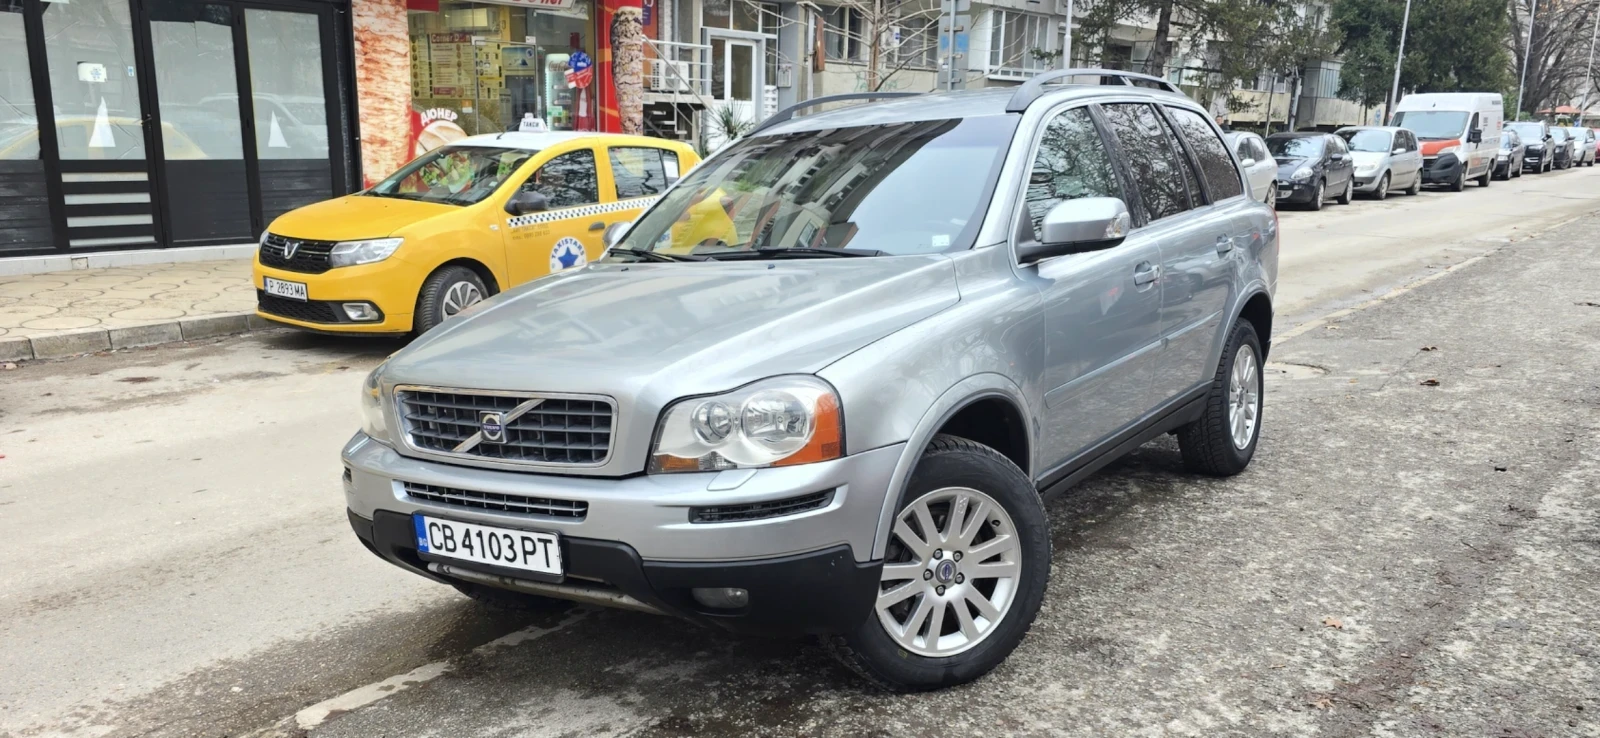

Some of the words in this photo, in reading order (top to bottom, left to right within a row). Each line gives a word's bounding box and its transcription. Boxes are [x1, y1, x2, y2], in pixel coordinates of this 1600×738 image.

[420, 107, 458, 126] ДЮНЕР
[551, 238, 585, 259] TAXISTARS
[462, 528, 517, 563] 4103
